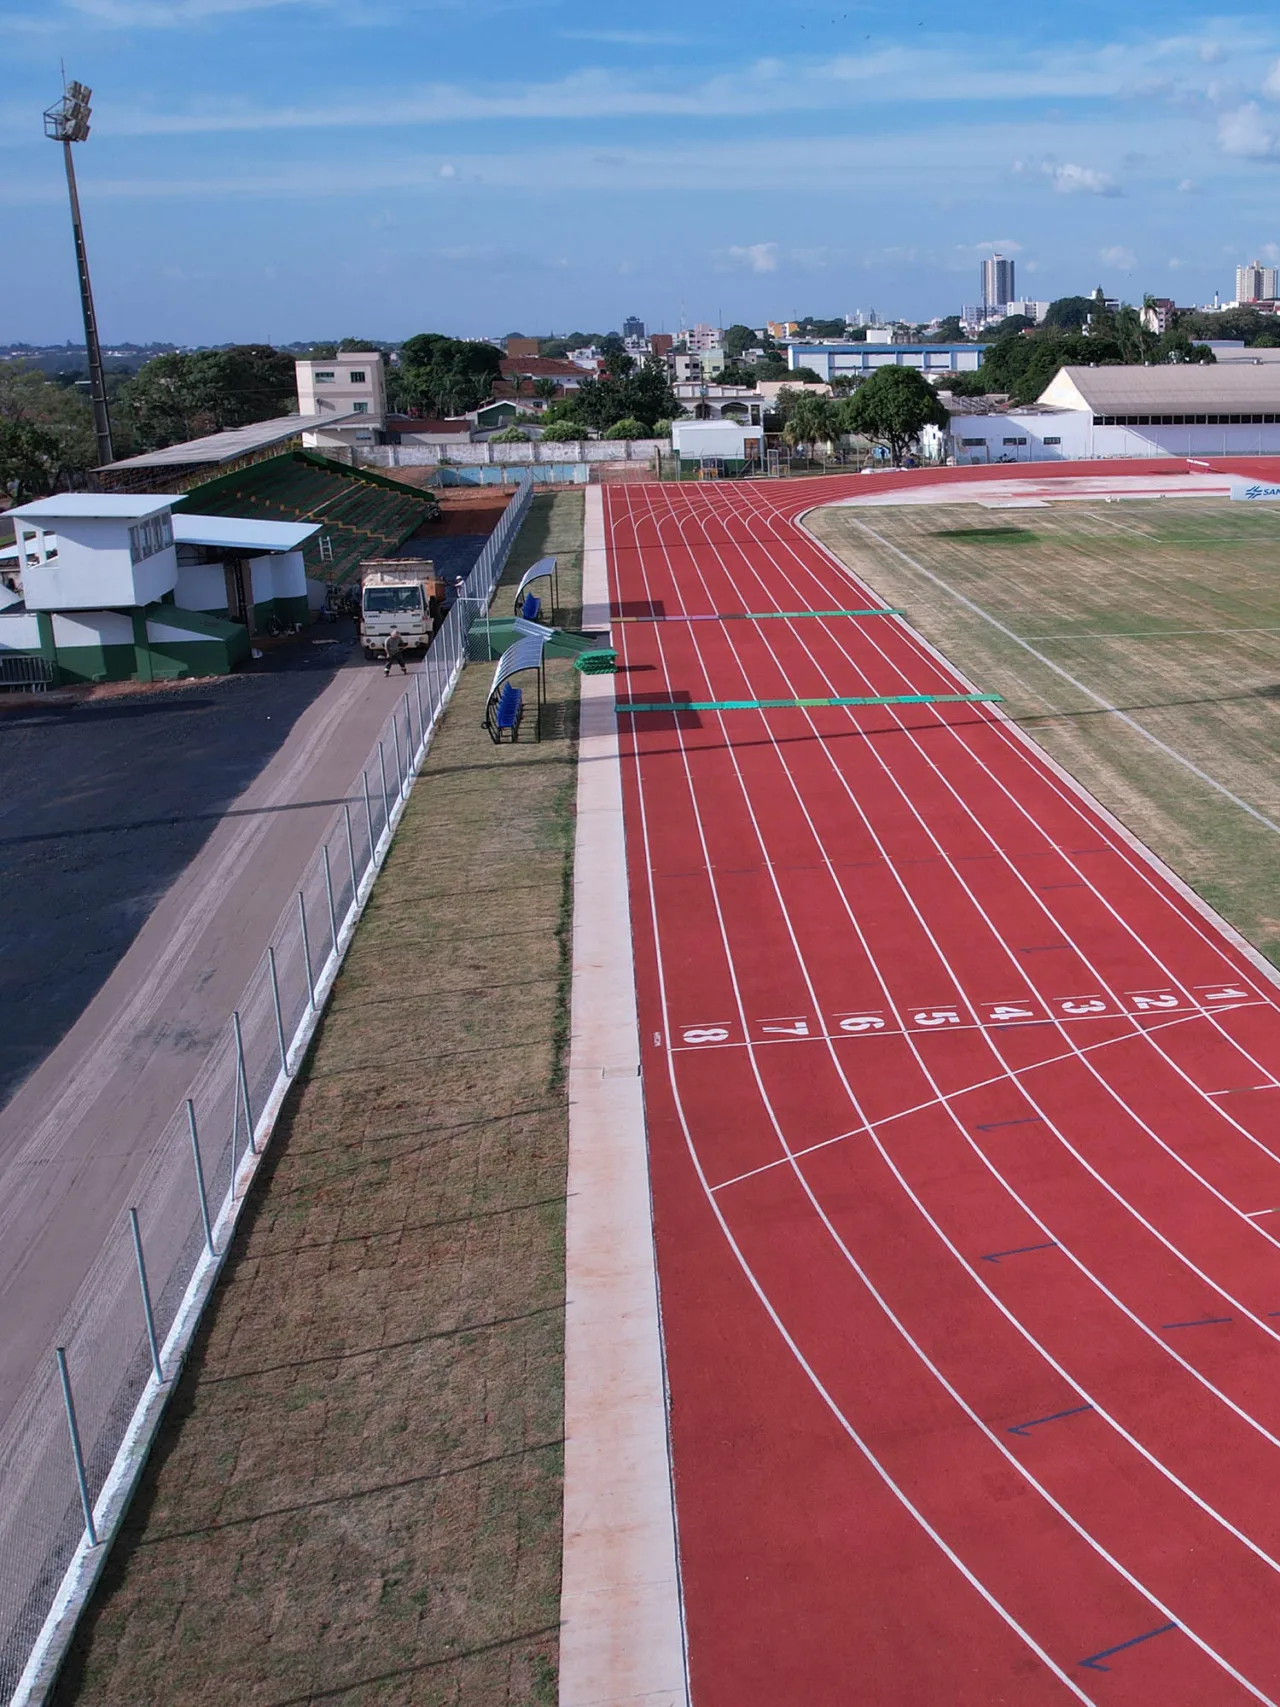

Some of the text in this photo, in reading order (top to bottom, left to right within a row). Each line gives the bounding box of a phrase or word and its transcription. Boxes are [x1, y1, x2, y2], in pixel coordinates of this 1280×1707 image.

[1131, 994, 1180, 1009] 2
[1205, 988, 1249, 1000] 1
[989, 1006, 1034, 1020] 4
[1061, 1000, 1107, 1014] 3
[839, 1016, 885, 1031] 6
[913, 1011, 960, 1026] 5
[682, 1027, 729, 1044] 8
[761, 1021, 809, 1036] 7
